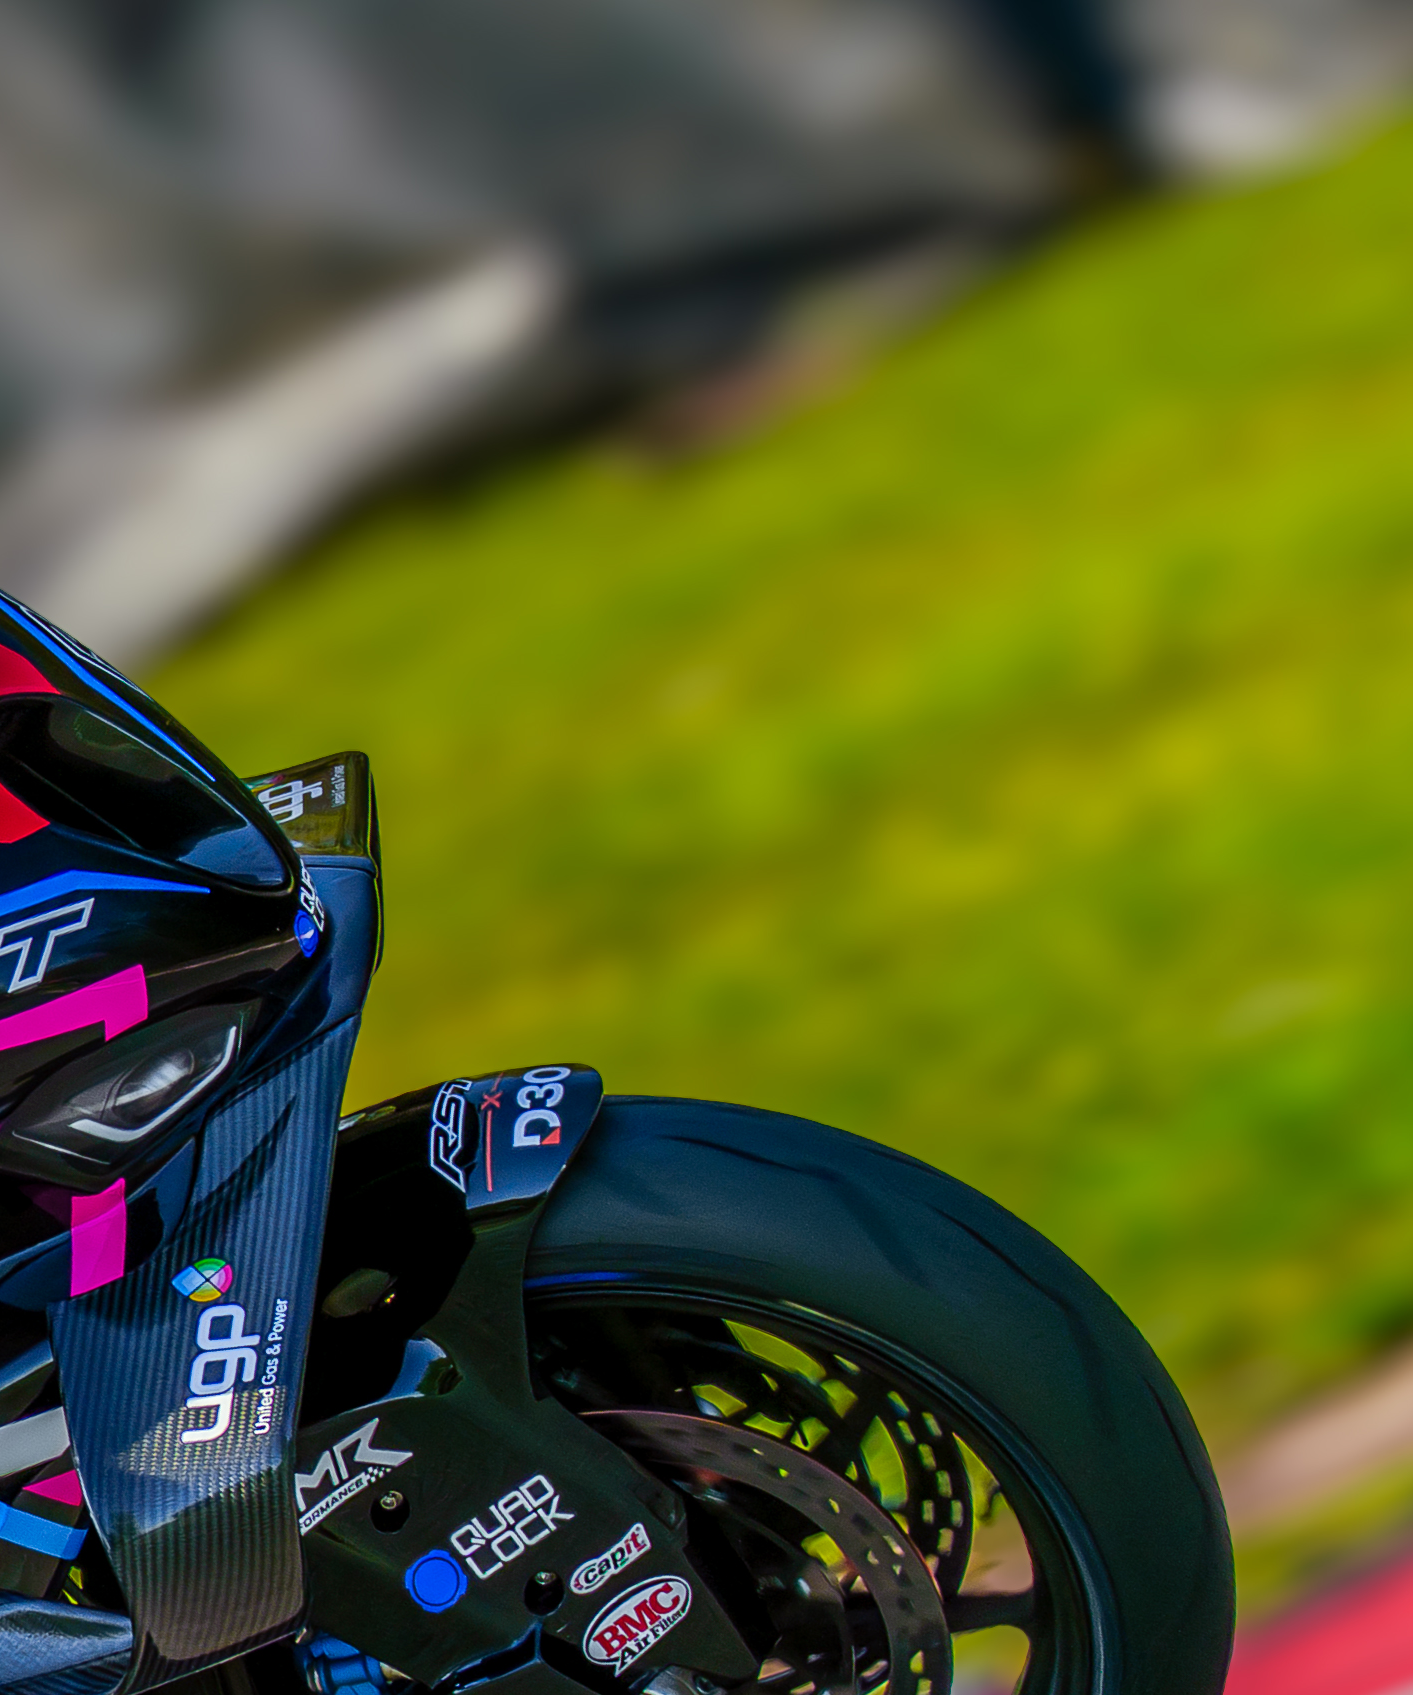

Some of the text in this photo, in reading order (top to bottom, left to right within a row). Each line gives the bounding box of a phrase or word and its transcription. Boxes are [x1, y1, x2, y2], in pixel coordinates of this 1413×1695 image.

[429, 1078, 473, 1194] RST
[180, 1303, 262, 1445] ugp
[253, 1298, 289, 1436] United Gas & Power
[300, 1477, 365, 1530] ORMANCE
[450, 1473, 555, 1557] QUAD
[465, 1494, 576, 1581] LOCK
[580, 1528, 647, 1587] capit
[592, 1582, 681, 1658] BMC
[621, 1632, 651, 1664] Air
